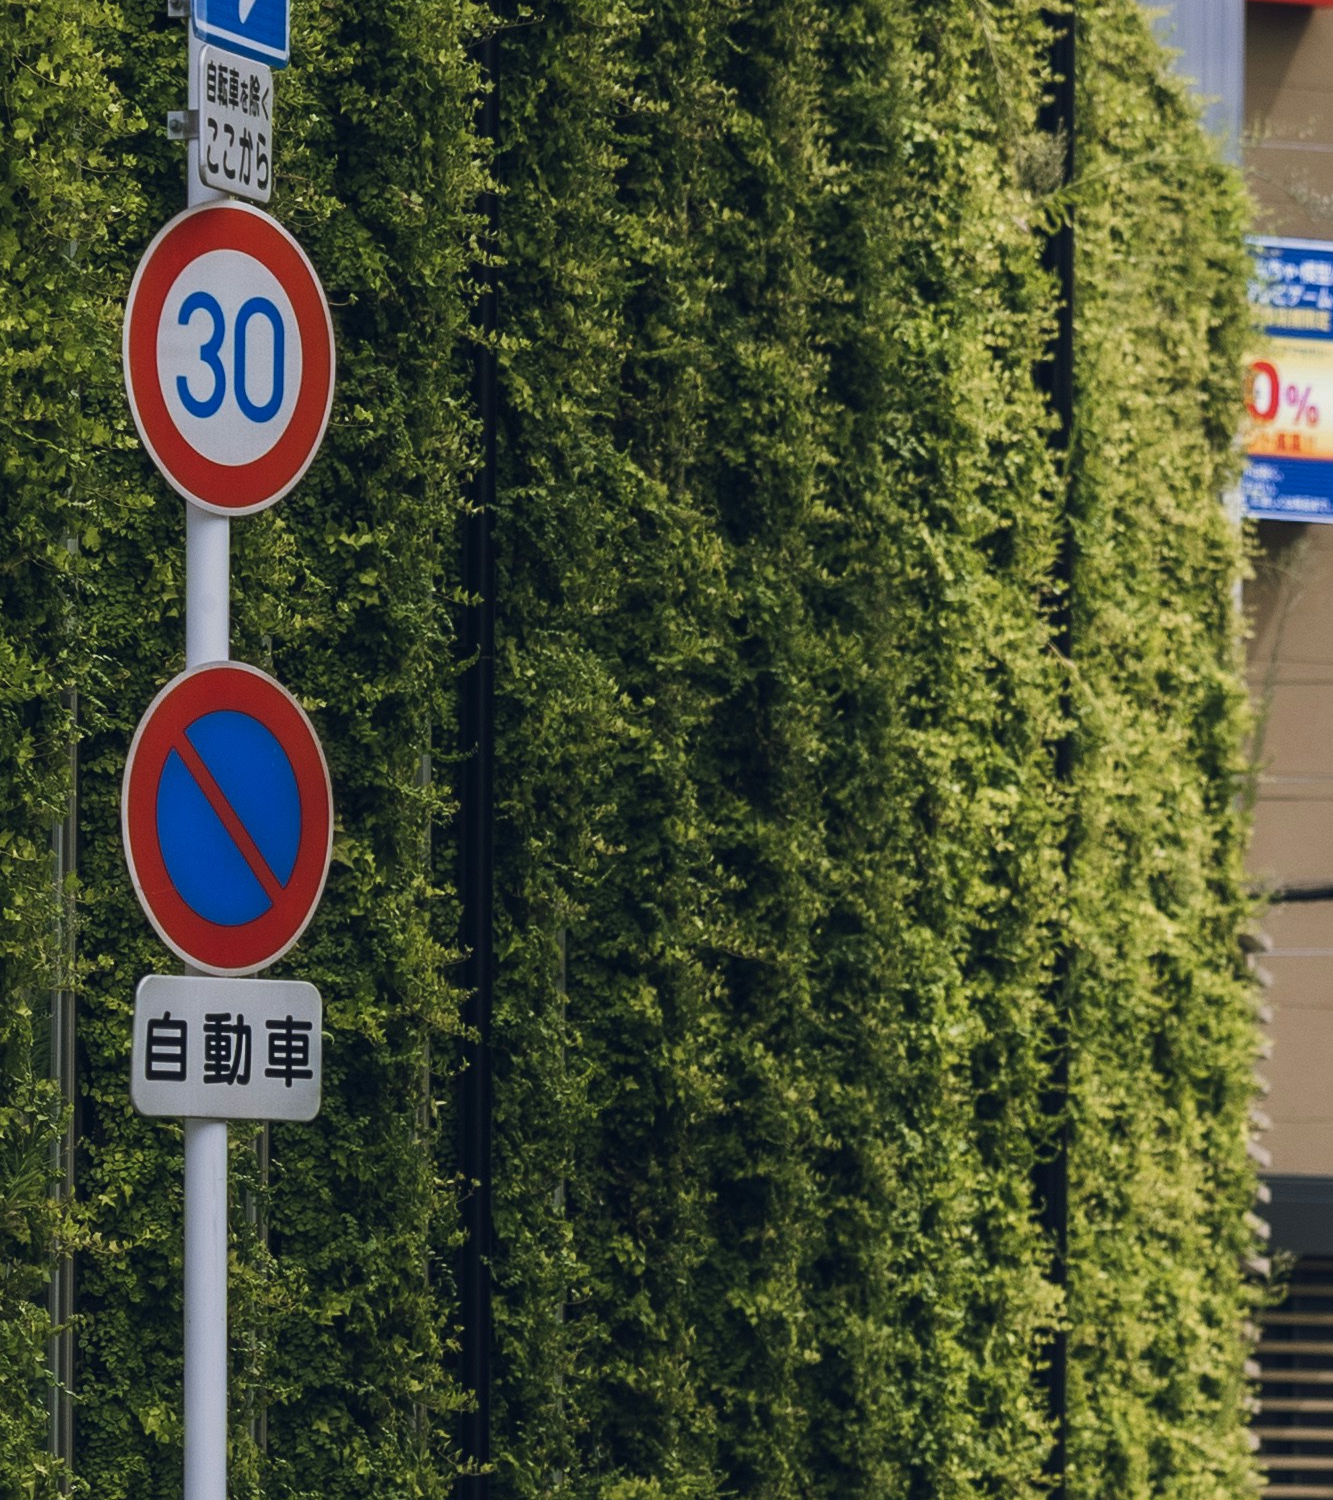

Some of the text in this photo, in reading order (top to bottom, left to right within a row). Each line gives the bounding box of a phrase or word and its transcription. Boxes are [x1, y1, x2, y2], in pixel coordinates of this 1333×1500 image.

[206, 60, 269, 121] 自転車を除く
[206, 117, 269, 191] ここから
[175, 290, 285, 423] 30
[145, 1011, 313, 1088] 自動車
